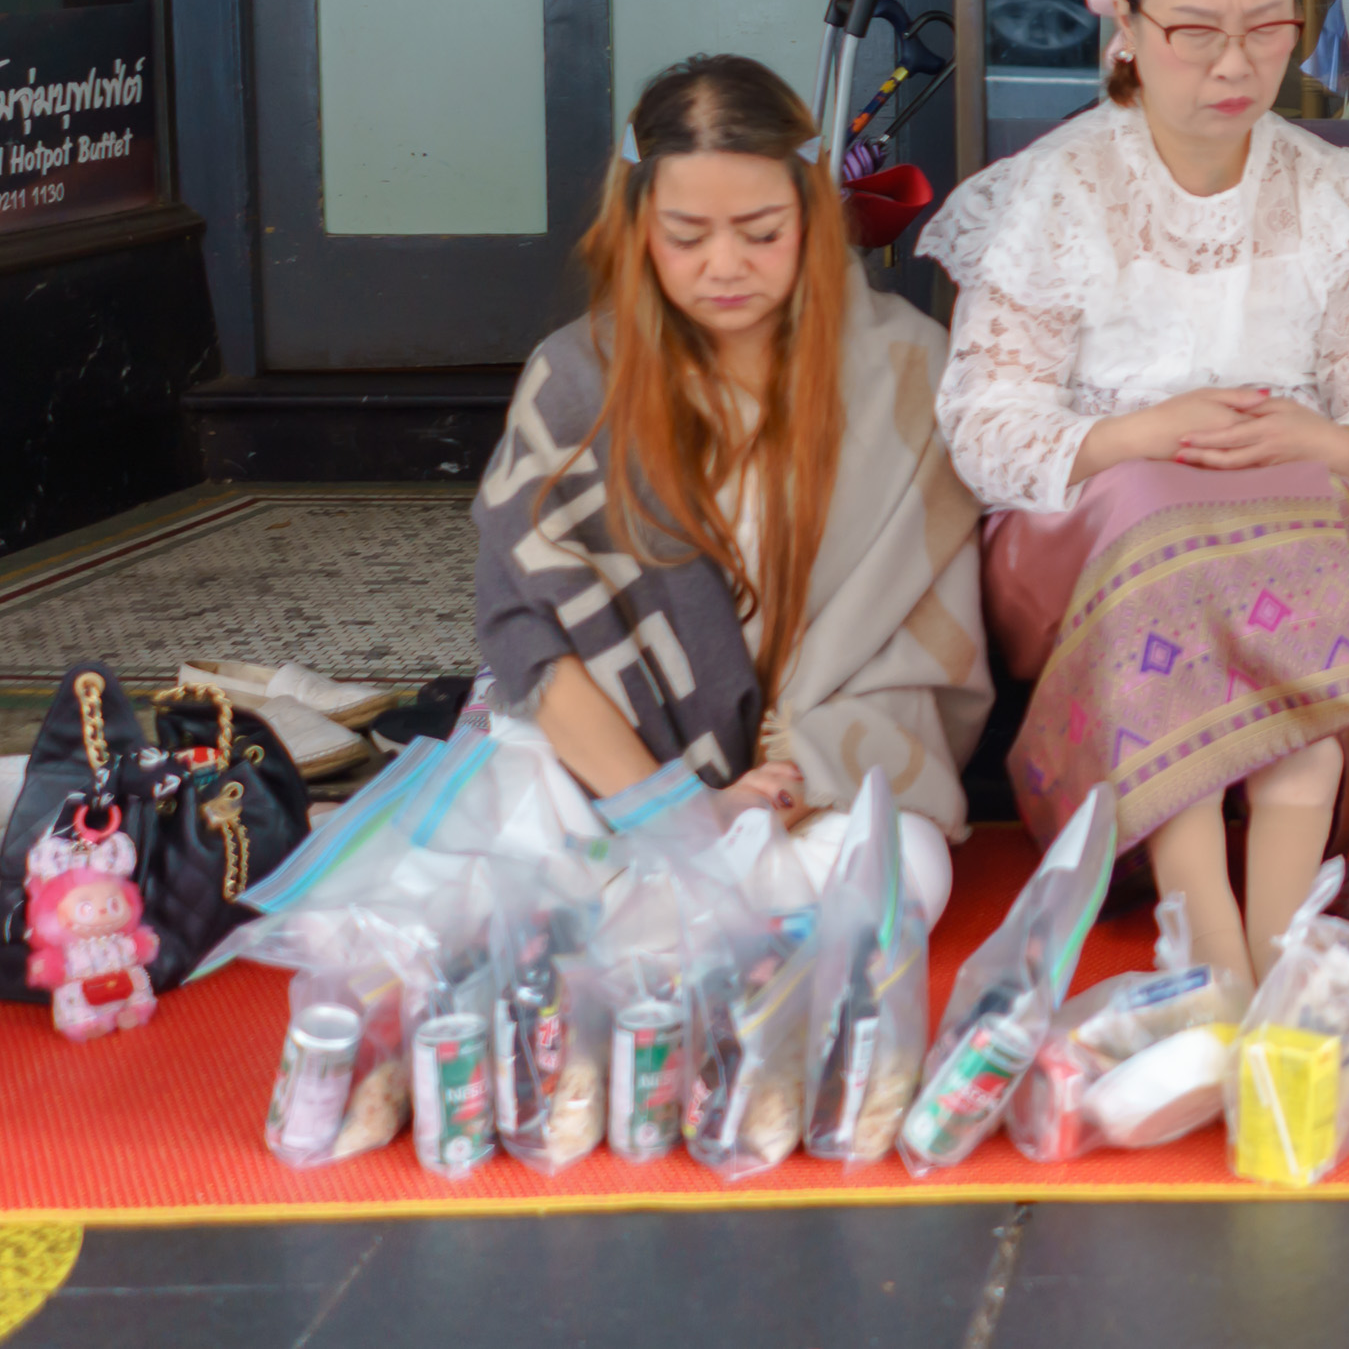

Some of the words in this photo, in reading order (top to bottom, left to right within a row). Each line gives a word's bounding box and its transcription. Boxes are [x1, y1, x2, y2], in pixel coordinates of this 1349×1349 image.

[10, 136, 73, 176] Hotpot
[77, 127, 134, 164] Buffet
[0, 188, 26, 211] 211
[32, 182, 65, 206] 1130
